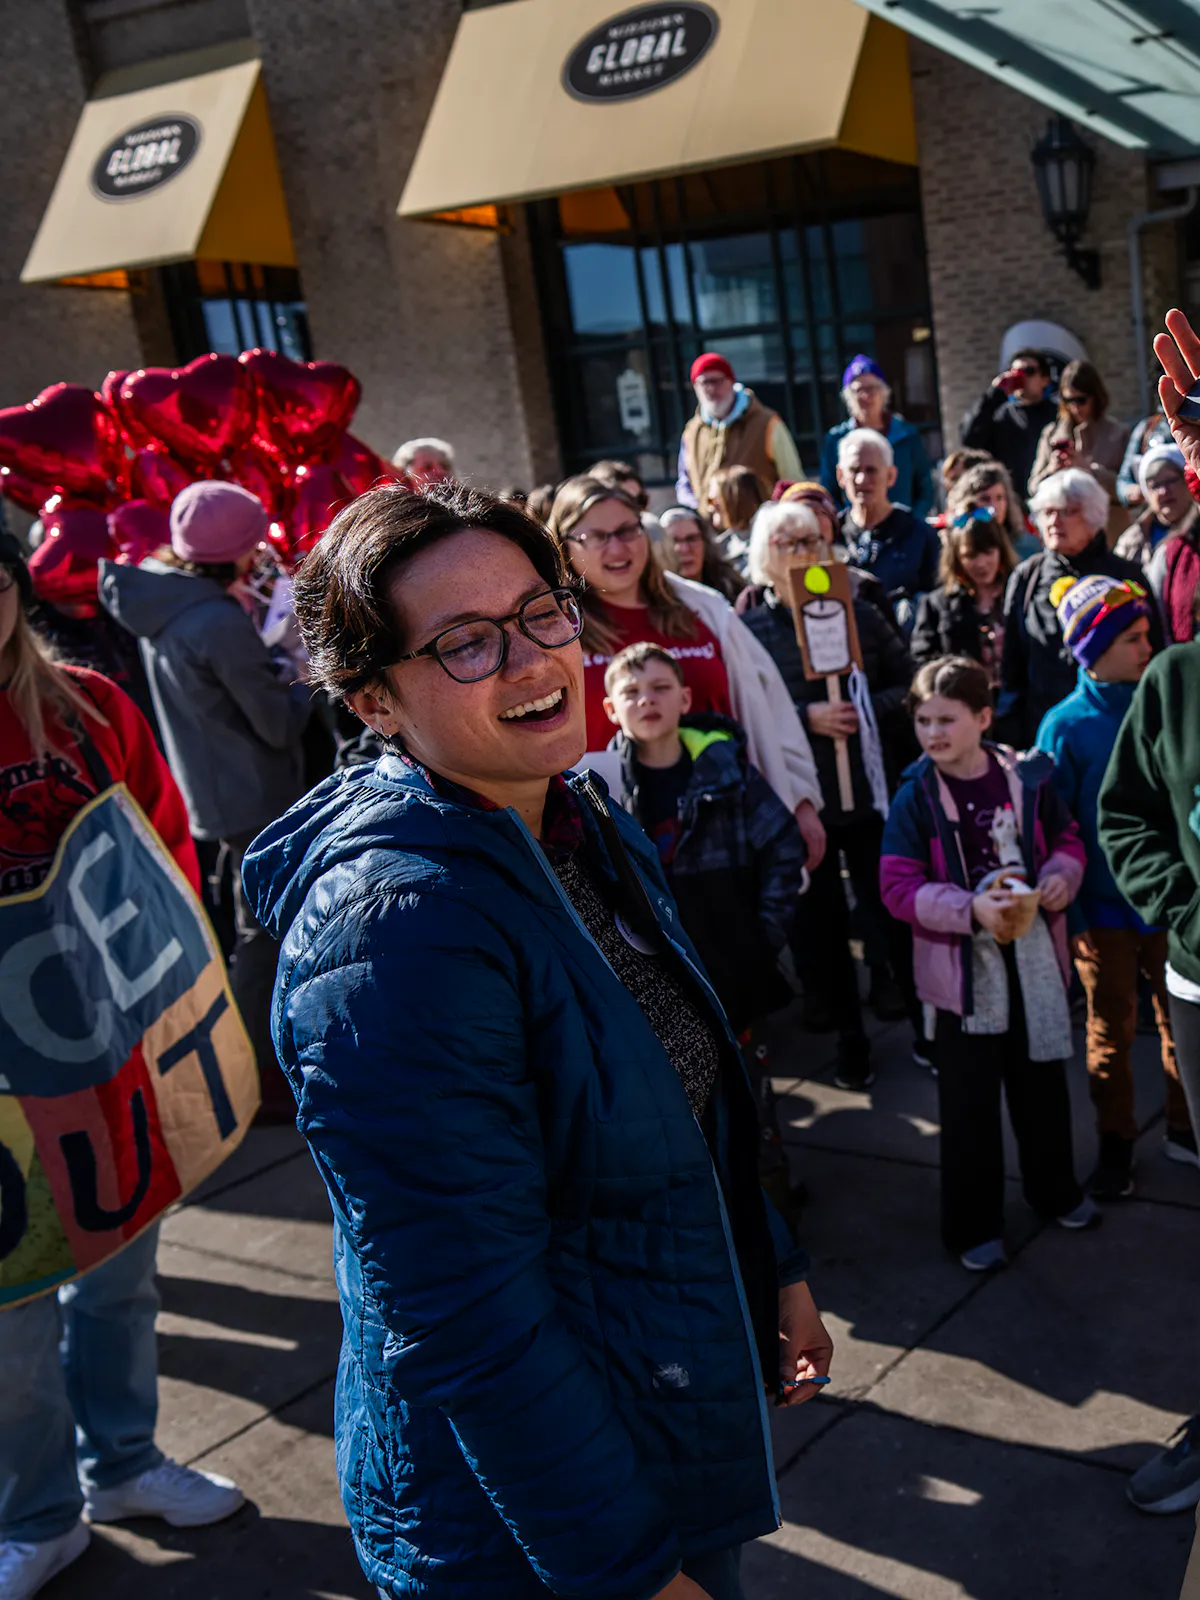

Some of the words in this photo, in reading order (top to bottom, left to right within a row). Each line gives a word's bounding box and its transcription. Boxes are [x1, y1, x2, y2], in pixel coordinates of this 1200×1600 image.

[587, 28, 686, 73] GLOBAL
[106, 137, 181, 176] GLOBAL
[0, 831, 184, 1092] CE
